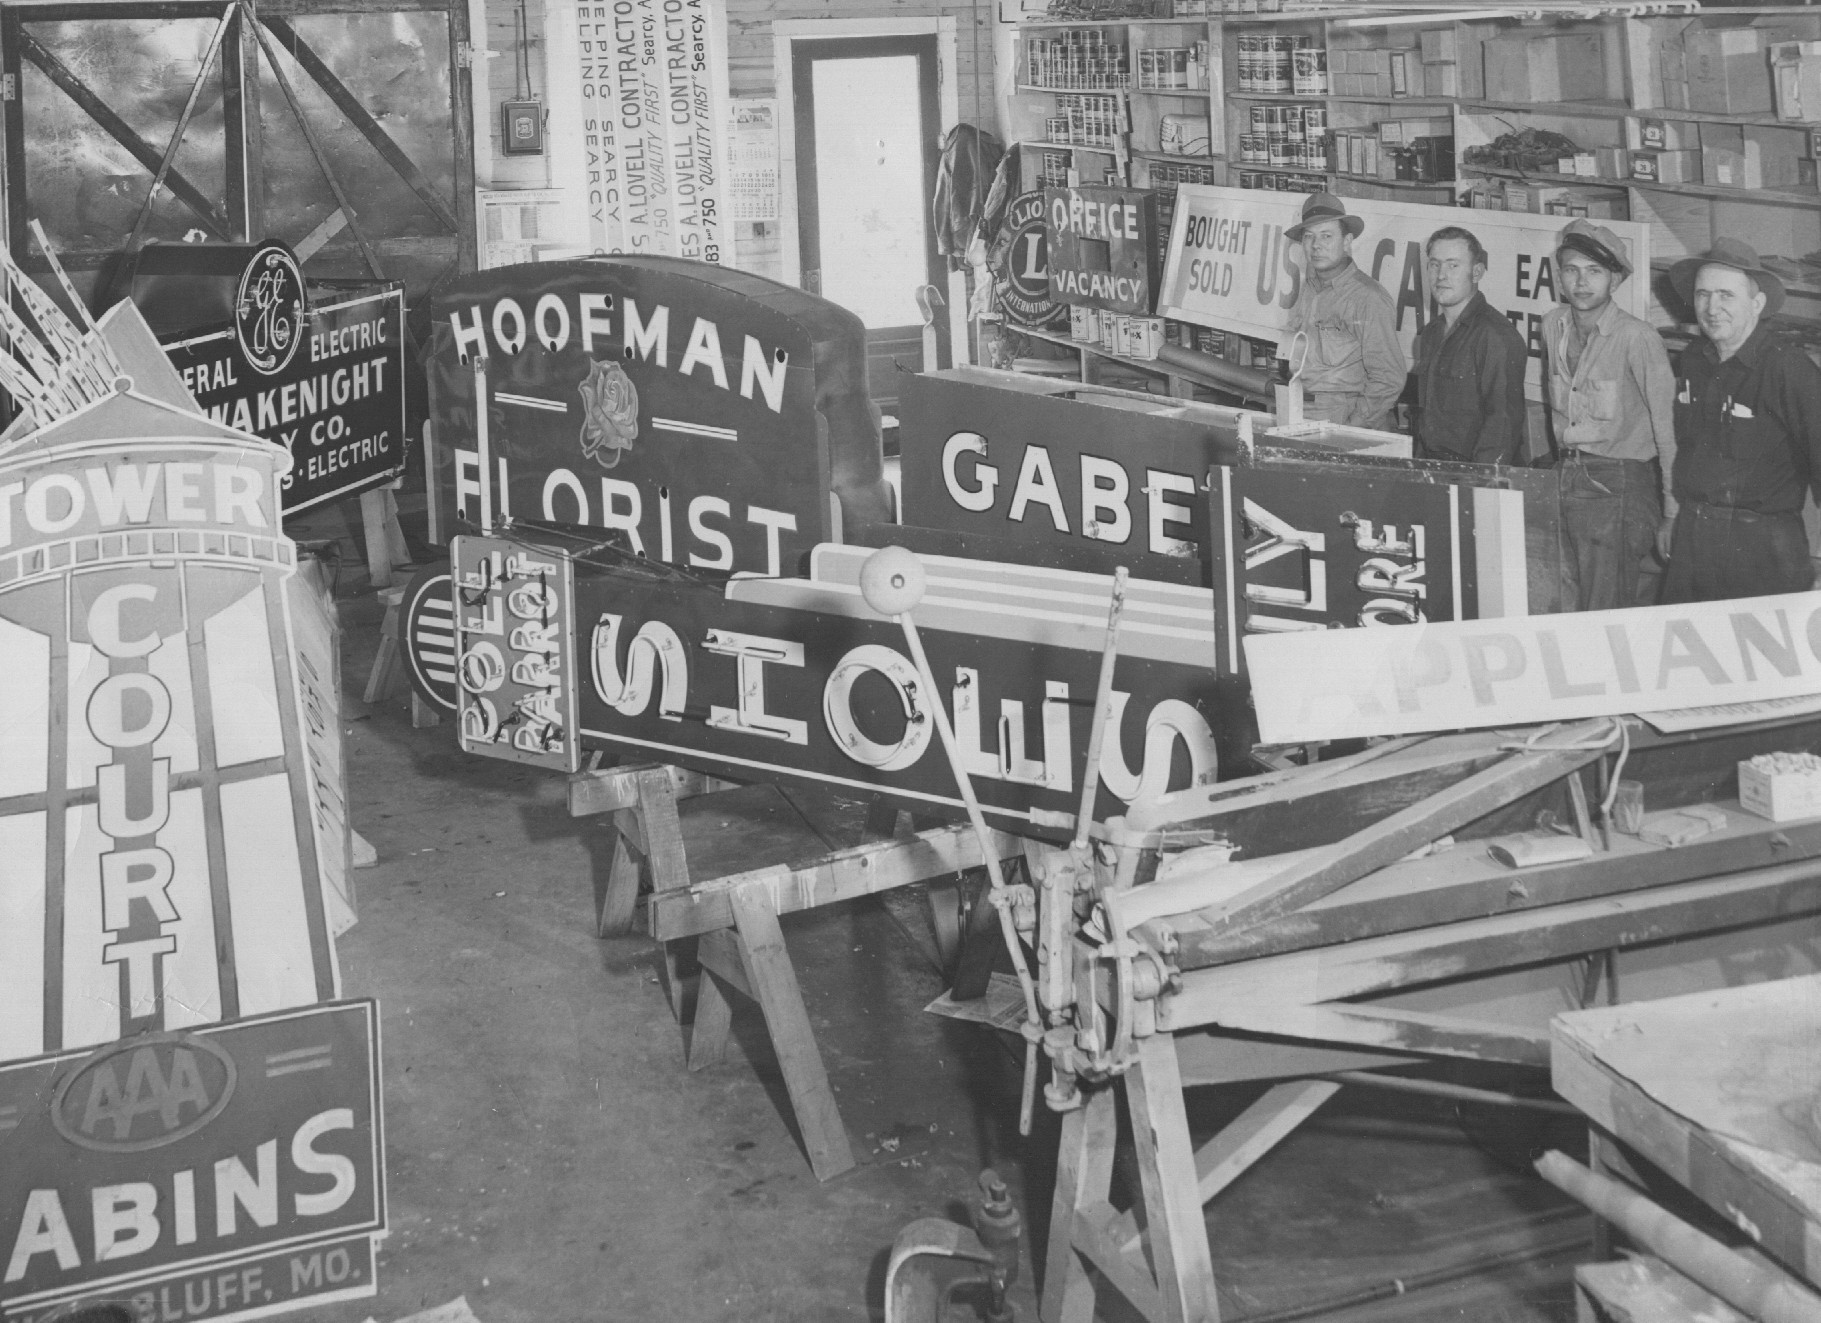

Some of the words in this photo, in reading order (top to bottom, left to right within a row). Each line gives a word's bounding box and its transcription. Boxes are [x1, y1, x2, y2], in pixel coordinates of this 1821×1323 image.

[613, 1, 641, 129] CONTRACTO
[585, 119, 603, 222] SEARCY
[602, 120, 620, 222] SEARCY
[1015, 200, 1045, 223] LIO
[701, 199, 717, 226] 750
[1052, 197, 1139, 240] OFFICE
[1185, 214, 1251, 255] BOUGHT
[704, 244, 720, 265] 83
[1021, 233, 1048, 280] L
[1055, 269, 1142, 304] VACANCY
[1189, 258, 1232, 297] SOLD
[1256, 223, 1301, 310] US
[1516, 253, 1569, 302] EA
[1005, 288, 1053, 315] INTERNATION
[180, 356, 238, 395] ERAL
[310, 318, 388, 363] ELECTRIC
[450, 292, 789, 413] HOOFMAN
[307, 430, 389, 481] ELECTRIC
[310, 415, 351, 446] CO.
[454, 448, 798, 577] FLORIST
[941, 431, 1201, 558] GABE
[459, 550, 506, 744] POLL
[509, 552, 564, 754] PARROT
[1297, 607, 1821, 722] APPLIAN
[591, 612, 1219, 806] SHOES
[86, 583, 182, 1019] COURT
[81, 1046, 210, 1139] AAA
[3, 1108, 357, 1283] ABINS
[131, 1267, 273, 1323] BLUFF,
[290, 1248, 362, 1294] MO.
